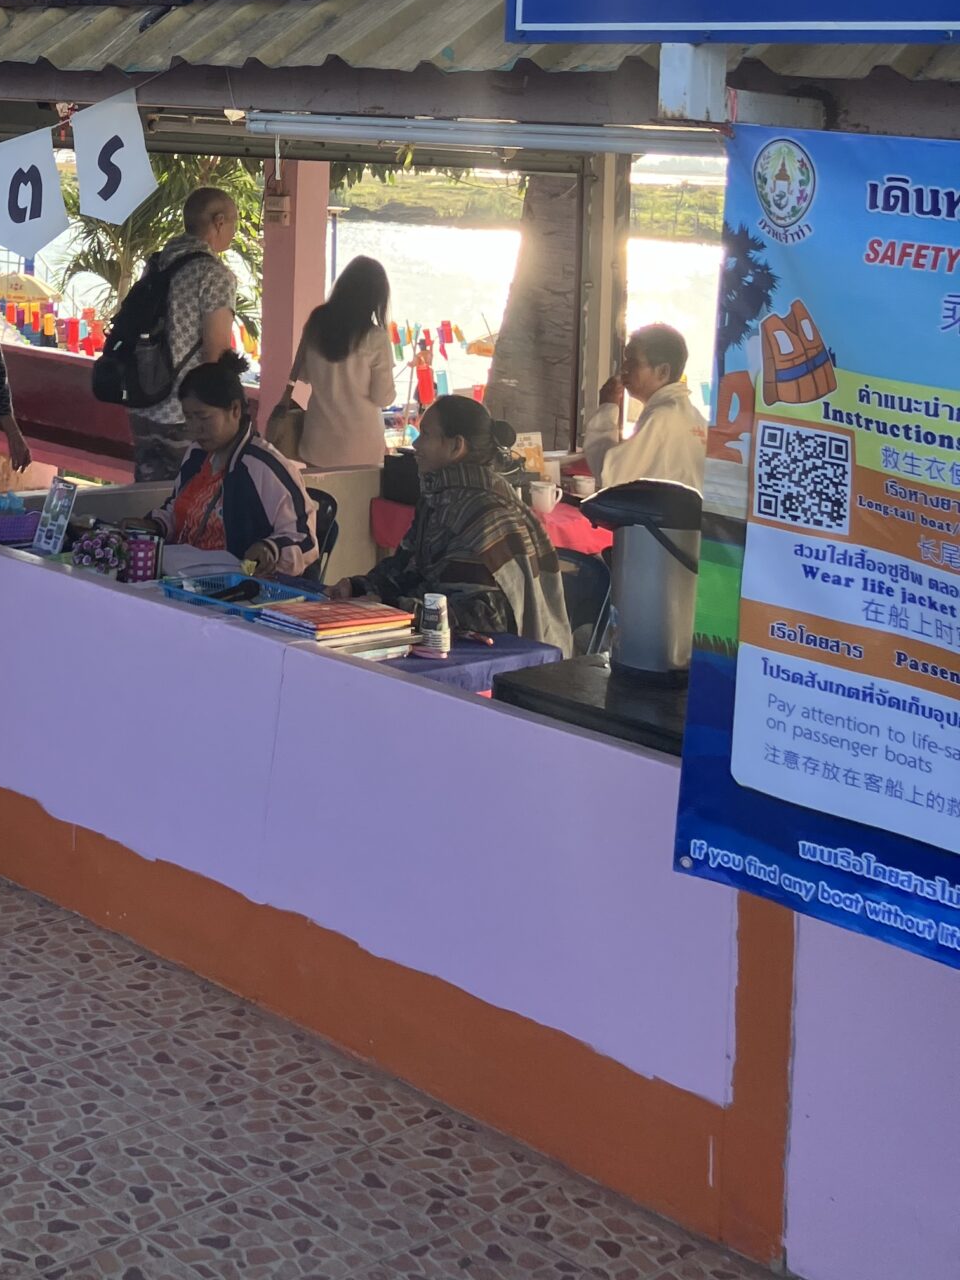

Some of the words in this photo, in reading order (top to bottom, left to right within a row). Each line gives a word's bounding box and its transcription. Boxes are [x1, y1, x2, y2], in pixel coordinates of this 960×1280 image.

[864, 238, 960, 274] SAFETY
[858, 384, 960, 423] คำแนะนำ
[858, 495, 916, 524] Long-tail
[802, 564, 854, 588] Wear
[862, 577, 895, 597] life
[901, 587, 957, 618] jacket
[929, 578, 960, 599] ตลอ
[769, 622, 864, 660] เรือโดยสาร
[862, 599, 960, 647] 在船上时
[762, 657, 960, 730] โปรดสังเกตที่จัดเก็บอุป
[768, 693, 796, 717] Pay
[801, 706, 880, 738] attention
[888, 725, 905, 744] to
[766, 717, 786, 733] on
[792, 724, 878, 758] passenger
[885, 745, 932, 773] boats
[690, 839, 707, 860] If
[709, 847, 743, 871] you
[745, 856, 779, 885] find
[781, 874, 816, 902] any
[818, 881, 864, 914] boat
[865, 901, 936, 940] without
